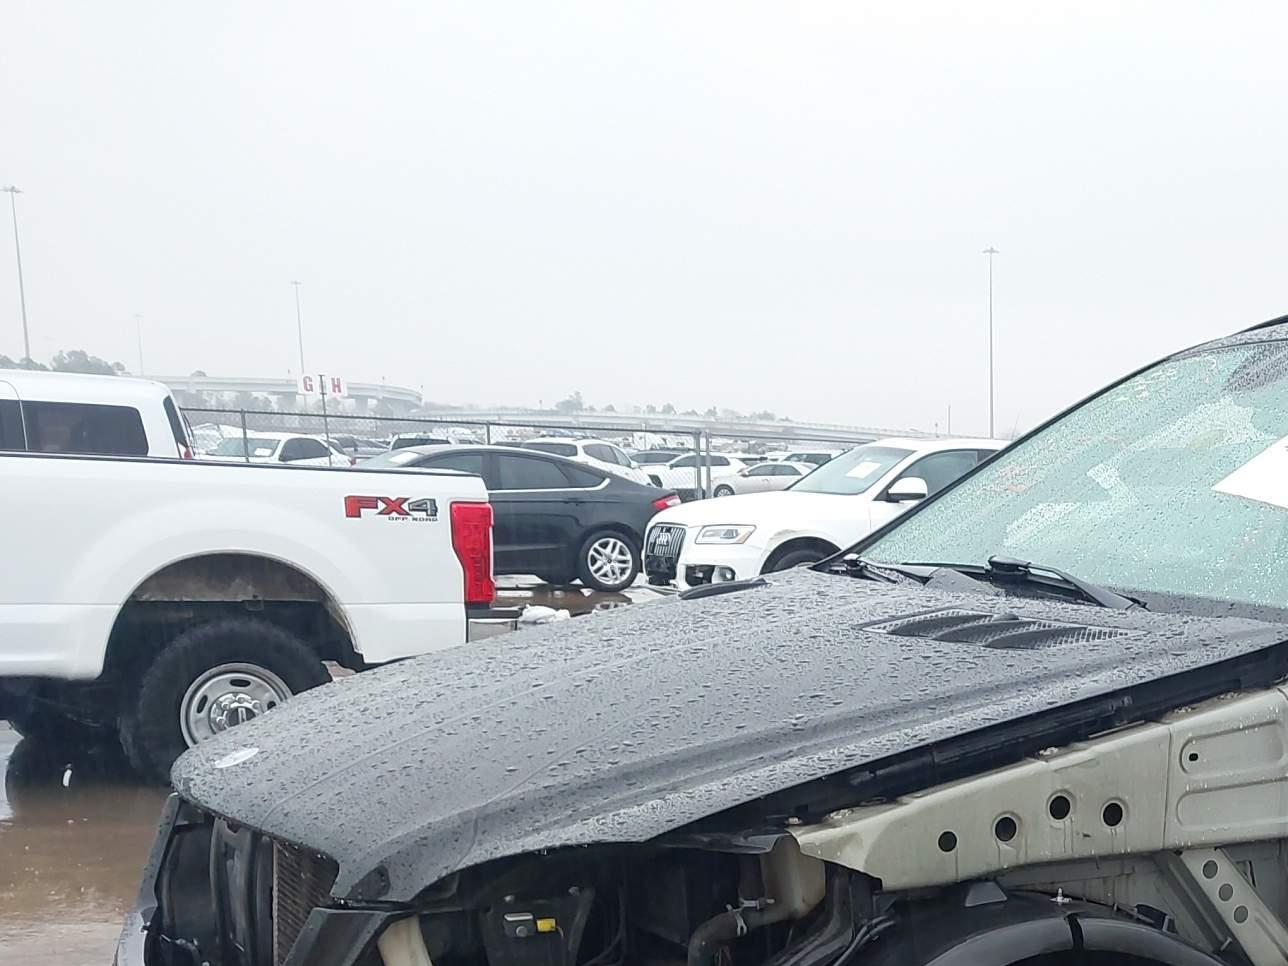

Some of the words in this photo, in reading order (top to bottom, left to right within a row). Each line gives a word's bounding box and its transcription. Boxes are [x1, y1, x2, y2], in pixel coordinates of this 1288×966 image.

[303, 376, 313, 392] G
[331, 377, 341, 393] H
[344, 496, 438, 518] FX4
